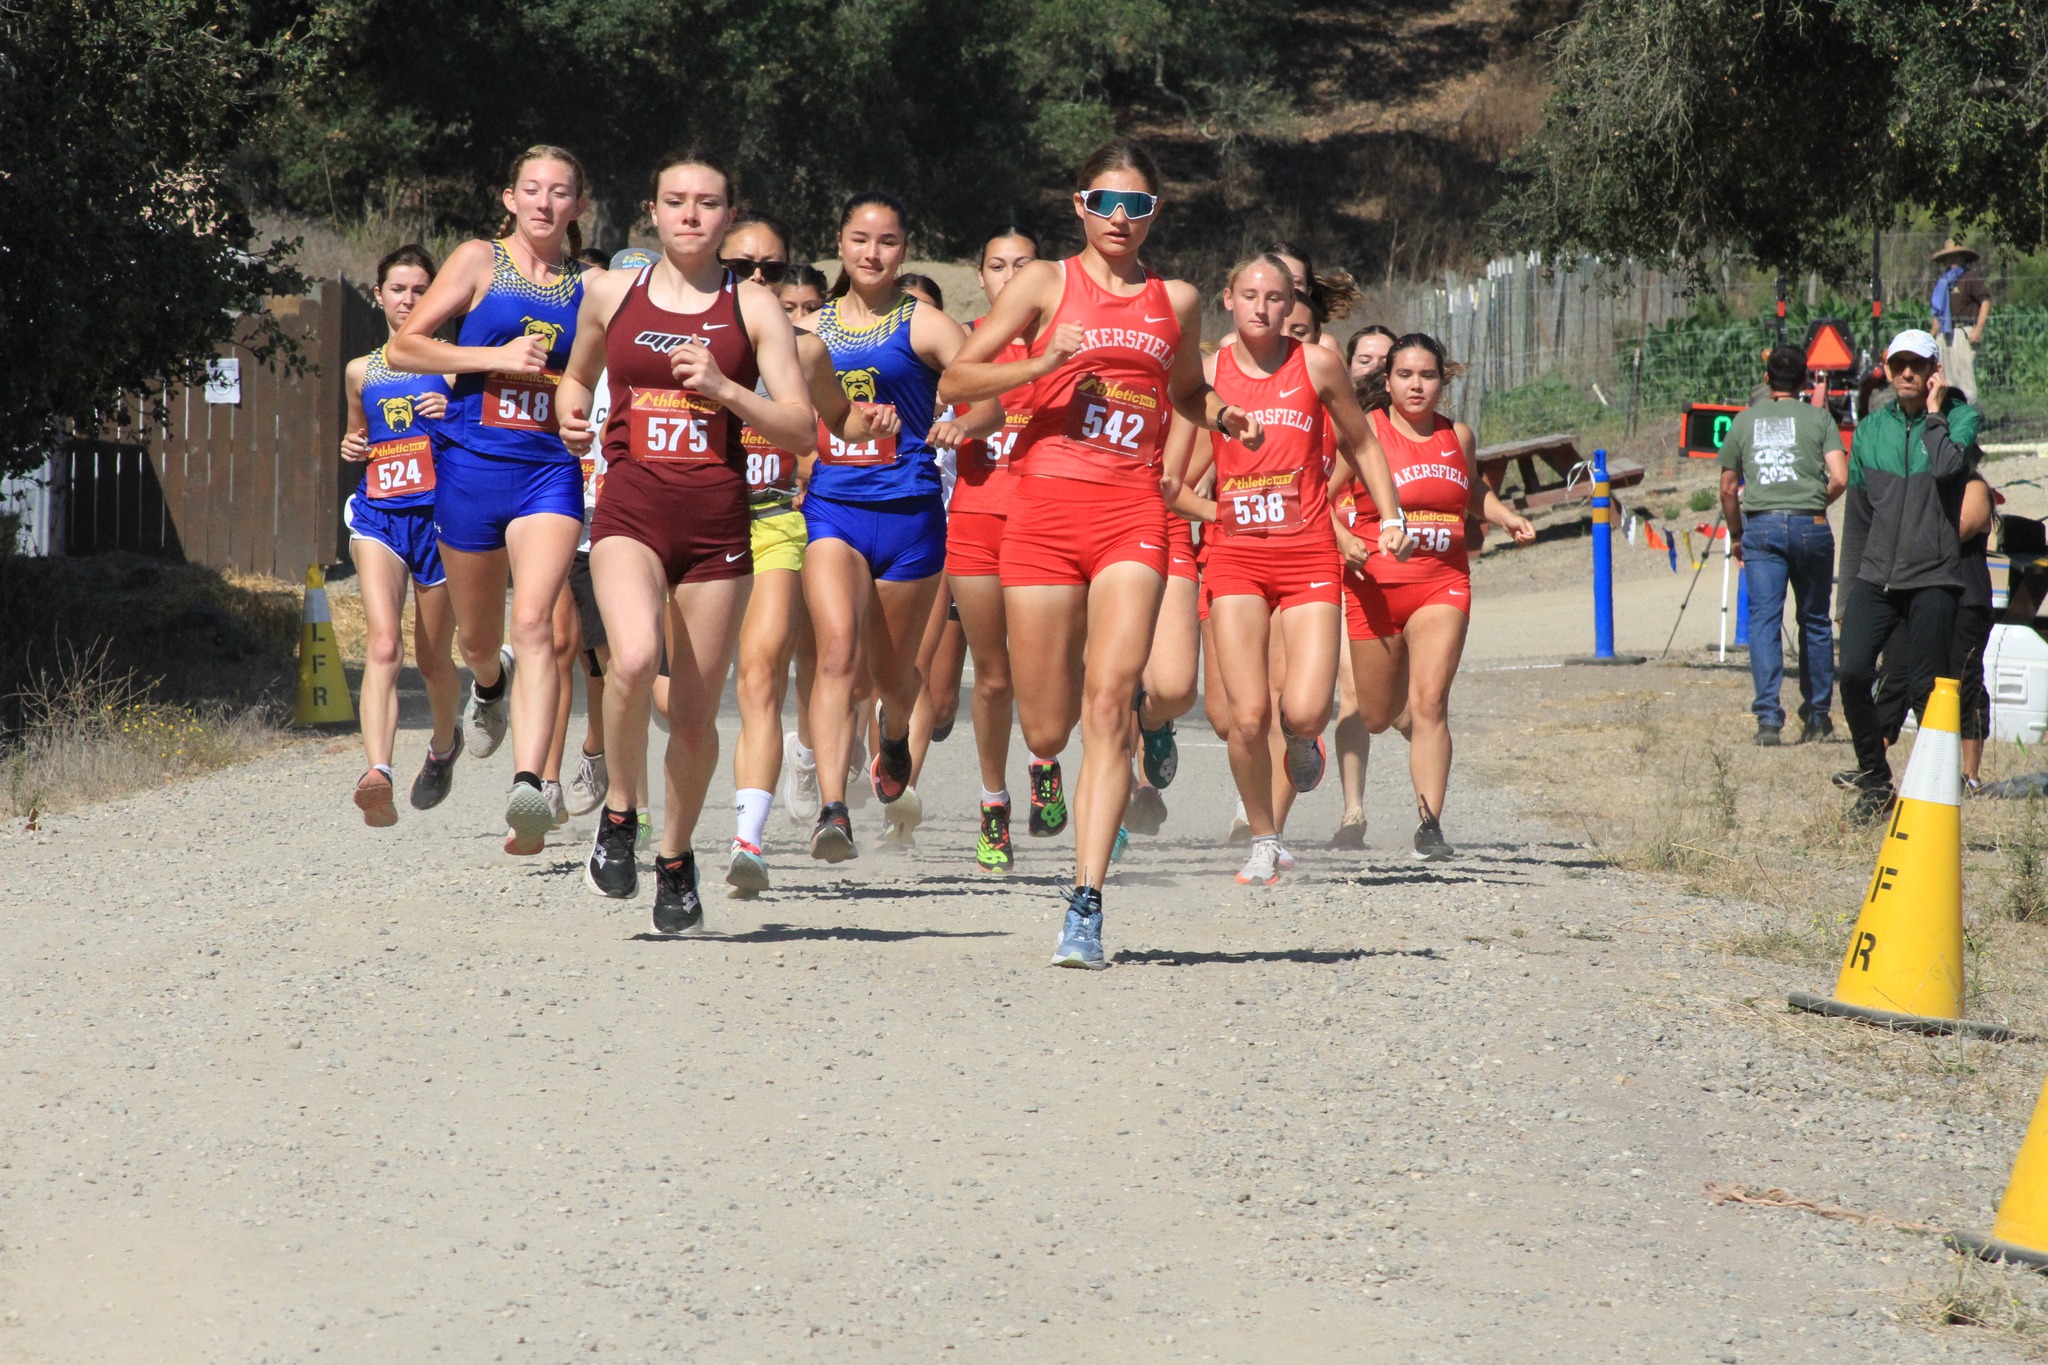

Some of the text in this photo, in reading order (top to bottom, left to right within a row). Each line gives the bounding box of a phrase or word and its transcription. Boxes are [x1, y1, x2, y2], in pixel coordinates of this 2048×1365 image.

[498, 389, 550, 422] 518
[647, 417, 708, 452] 575
[1082, 403, 1144, 449] 542
[378, 459, 422, 490] 524
[1233, 493, 1284, 525] 538
[1404, 511, 1443, 522] thletic
[1407, 527, 1451, 552] 536
